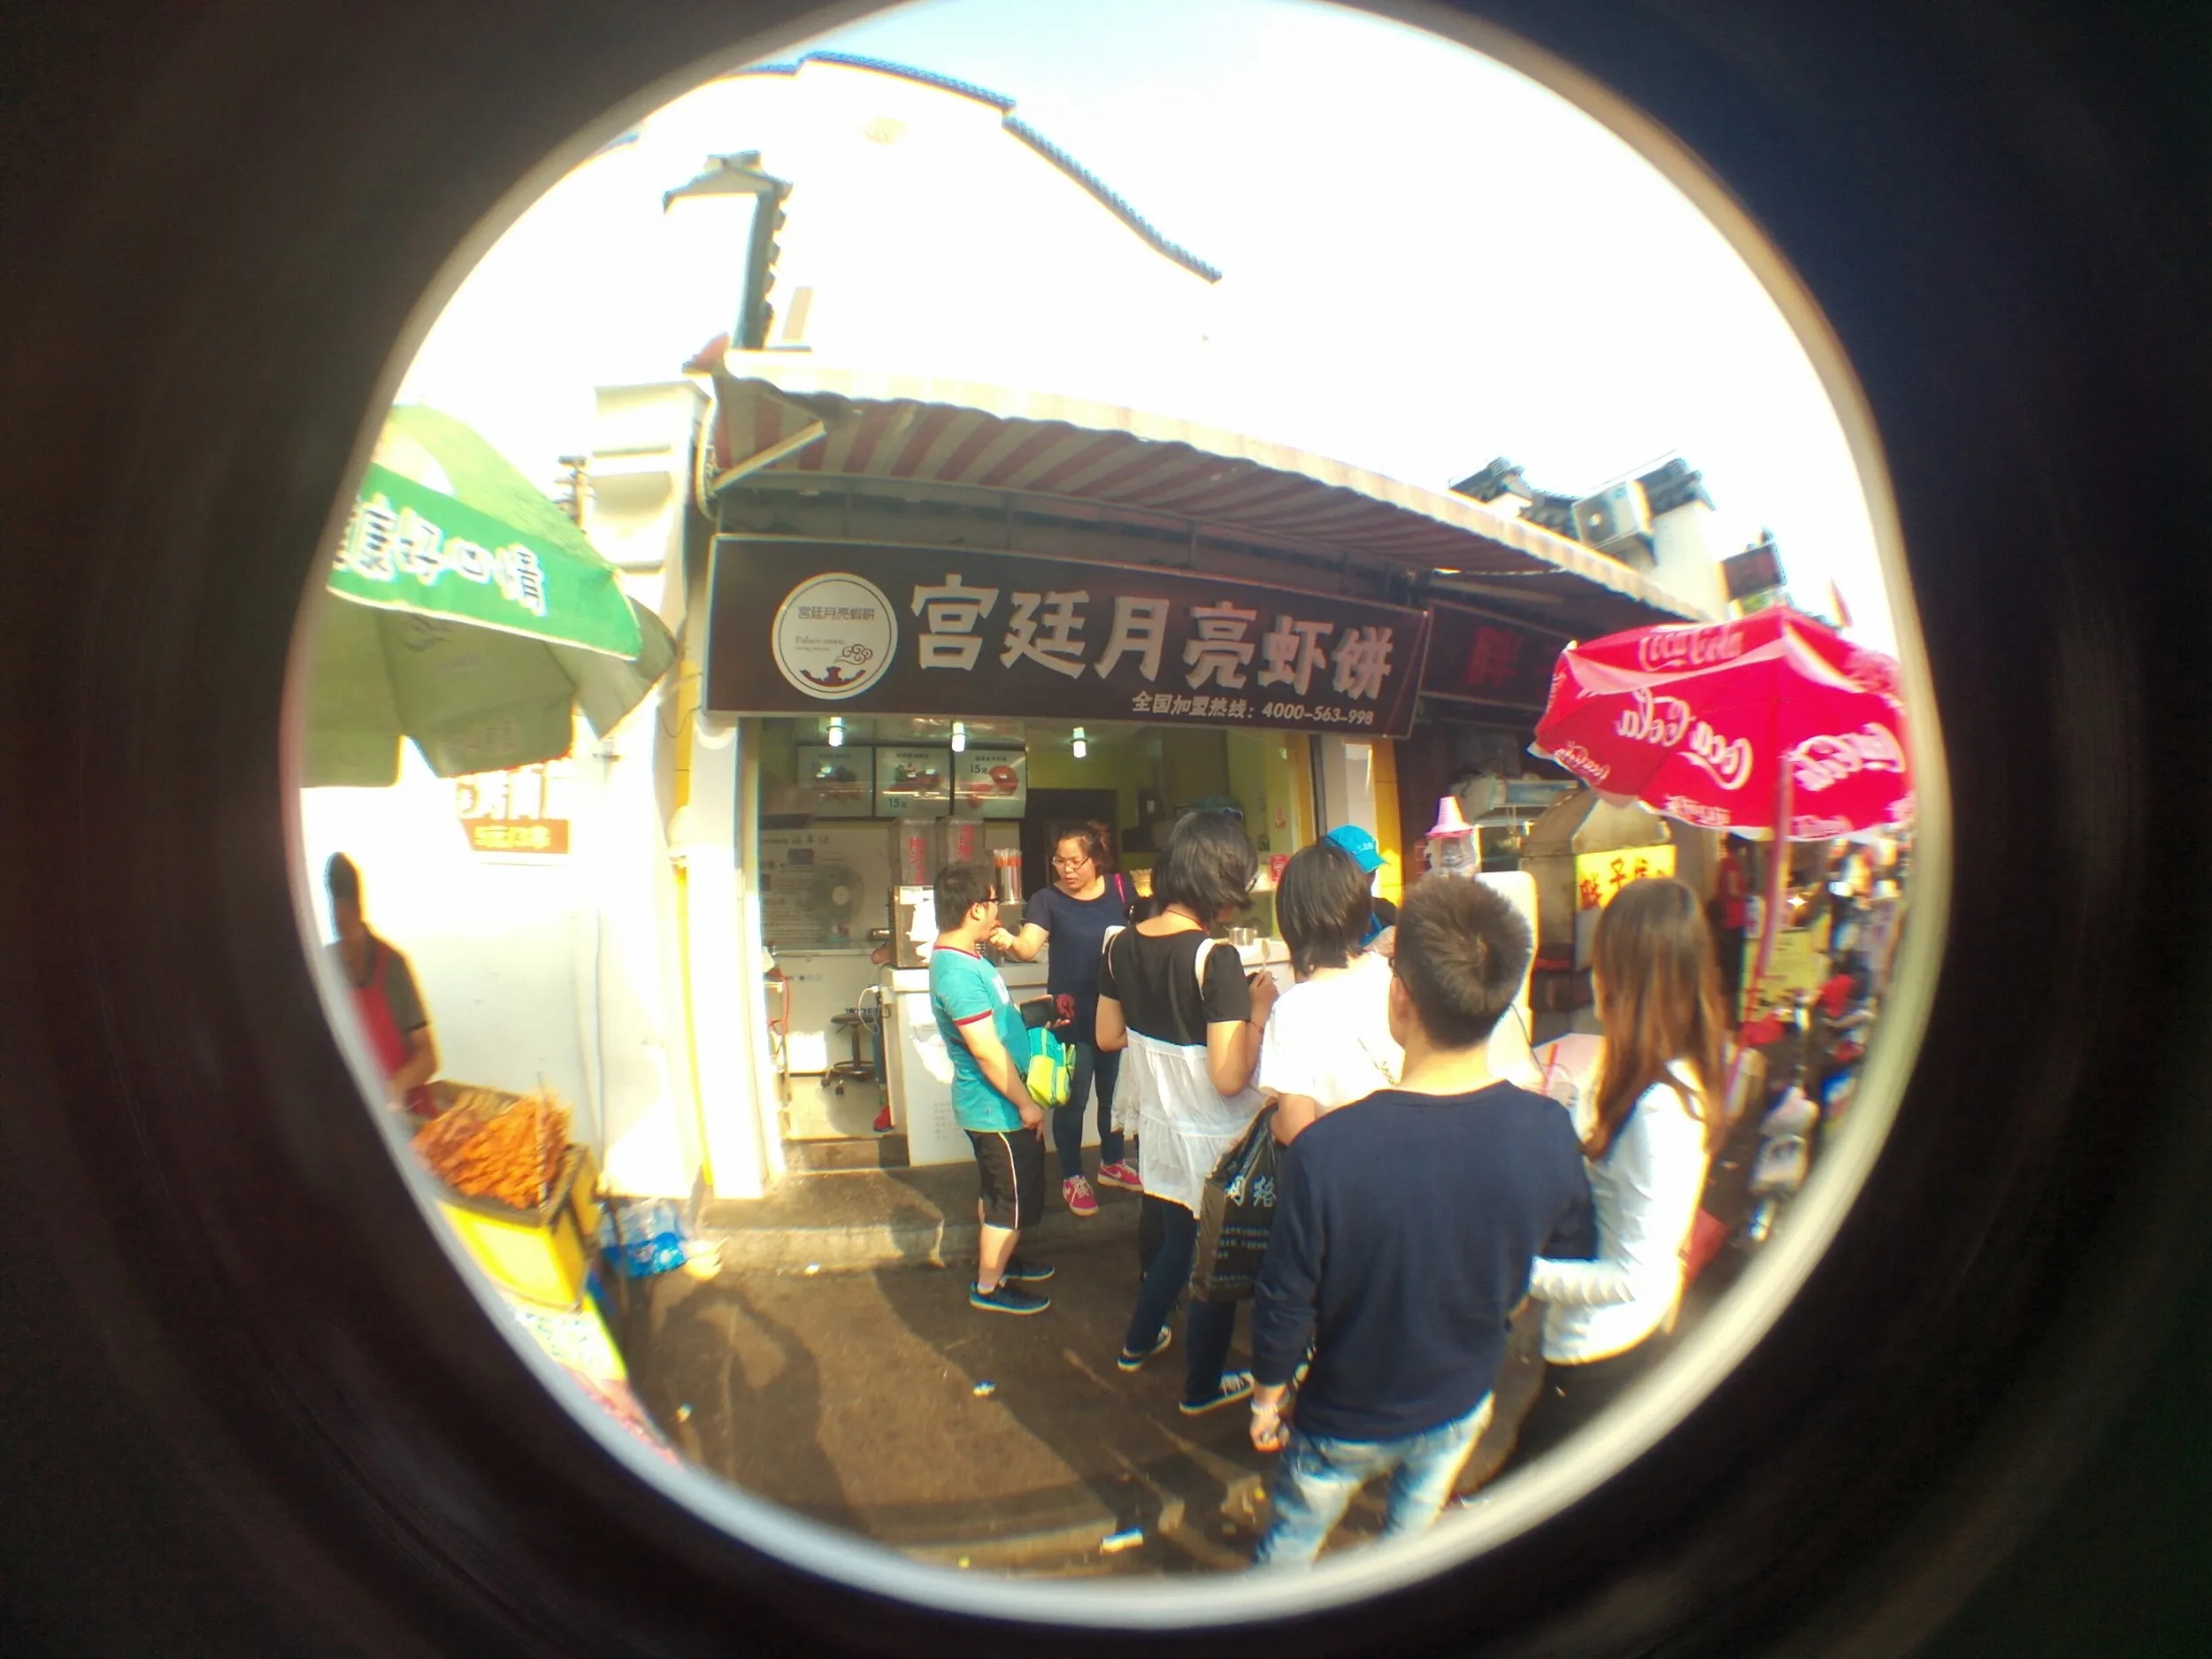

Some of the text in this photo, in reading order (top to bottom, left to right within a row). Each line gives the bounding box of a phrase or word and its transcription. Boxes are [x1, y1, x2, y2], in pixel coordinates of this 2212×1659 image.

[910, 573, 1394, 701] 宫廷月亮虾饼
[1262, 702, 1374, 726] 4000-563-998
